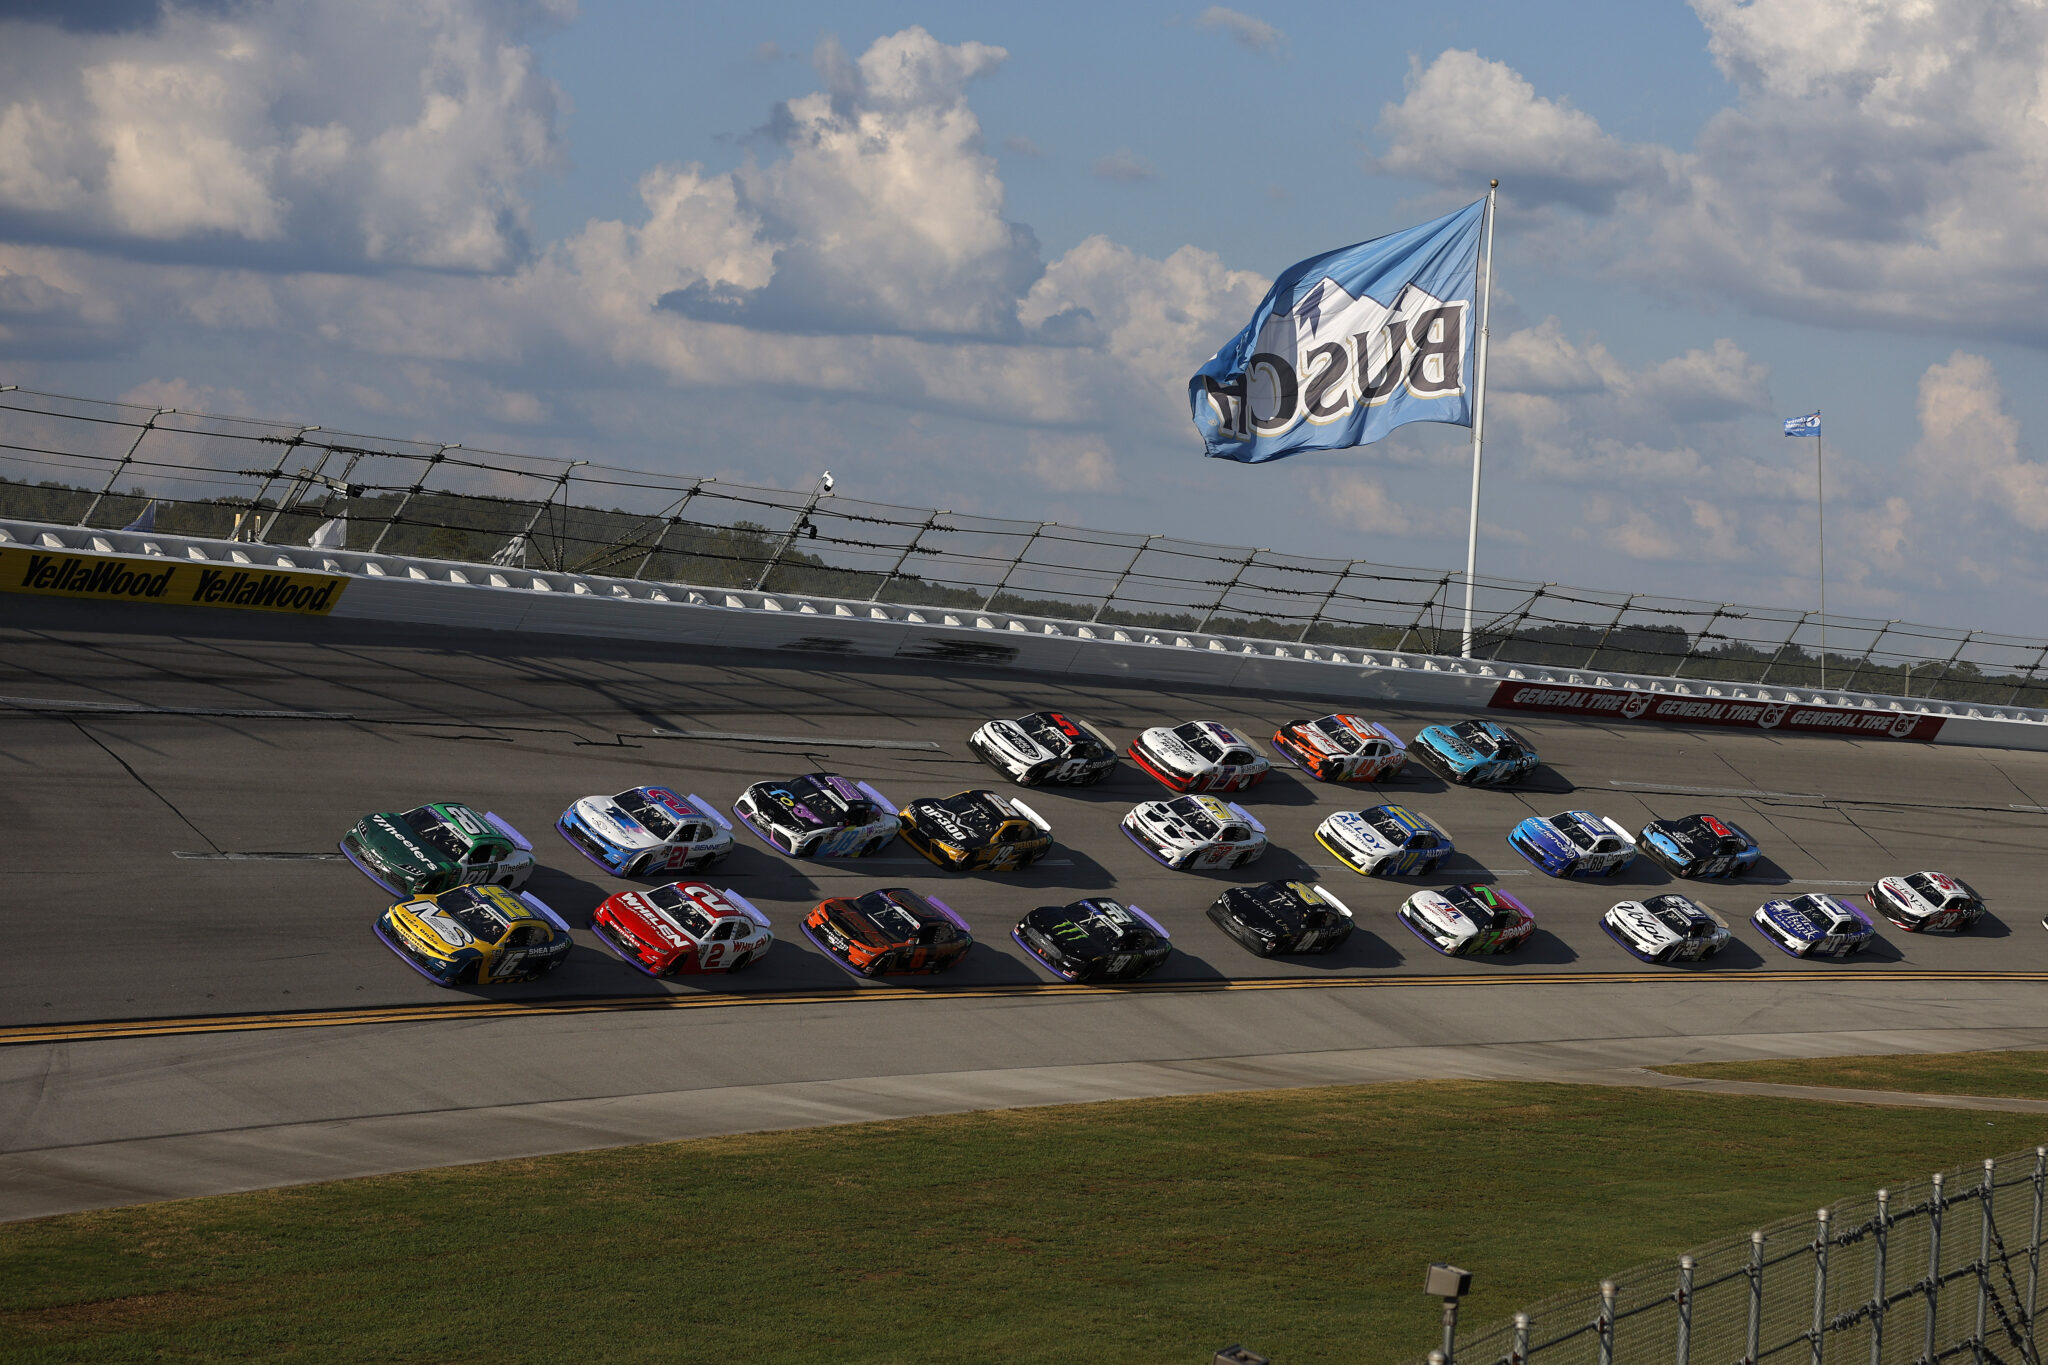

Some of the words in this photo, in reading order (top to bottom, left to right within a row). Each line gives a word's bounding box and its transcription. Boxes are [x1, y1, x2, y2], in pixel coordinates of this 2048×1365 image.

[1513, 688, 1586, 708] GENERAL
[1585, 694, 1627, 711] TIRE
[1656, 700, 1726, 720] GENERAL
[1725, 705, 1760, 721] TIRE
[1050, 713, 1080, 736] 5
[1790, 710, 1858, 727] GENERAL
[1857, 715, 1894, 731] TIRE
[825, 776, 864, 801] 18
[647, 789, 700, 816] 21
[444, 806, 490, 835] 81
[1387, 806, 1425, 829] 11
[372, 814, 438, 871] Wheelers
[1335, 815, 1386, 850] ALLOY
[1354, 832, 1373, 852] Services
[1526, 818, 1569, 852] Clarience
[666, 846, 689, 869] 21
[1931, 873, 1958, 891] 39
[474, 885, 533, 920] 16
[684, 886, 736, 911] 2
[1473, 886, 1498, 906] 7
[1885, 877, 1928, 912] SciAps
[621, 892, 691, 948] WHELEN
[1252, 899, 1275, 918] Gets
[400, 914, 419, 928] SHEA
[1617, 901, 1670, 943] Volpi
[1787, 914, 1816, 941] Bank
[1793, 913, 1821, 935] First
[1938, 912, 1958, 929] 39
[733, 934, 767, 953] WHELEN
[1483, 931, 1501, 950] 7
[1682, 941, 1700, 956] 32
[493, 952, 526, 976] 16
[704, 943, 725, 968] 2
